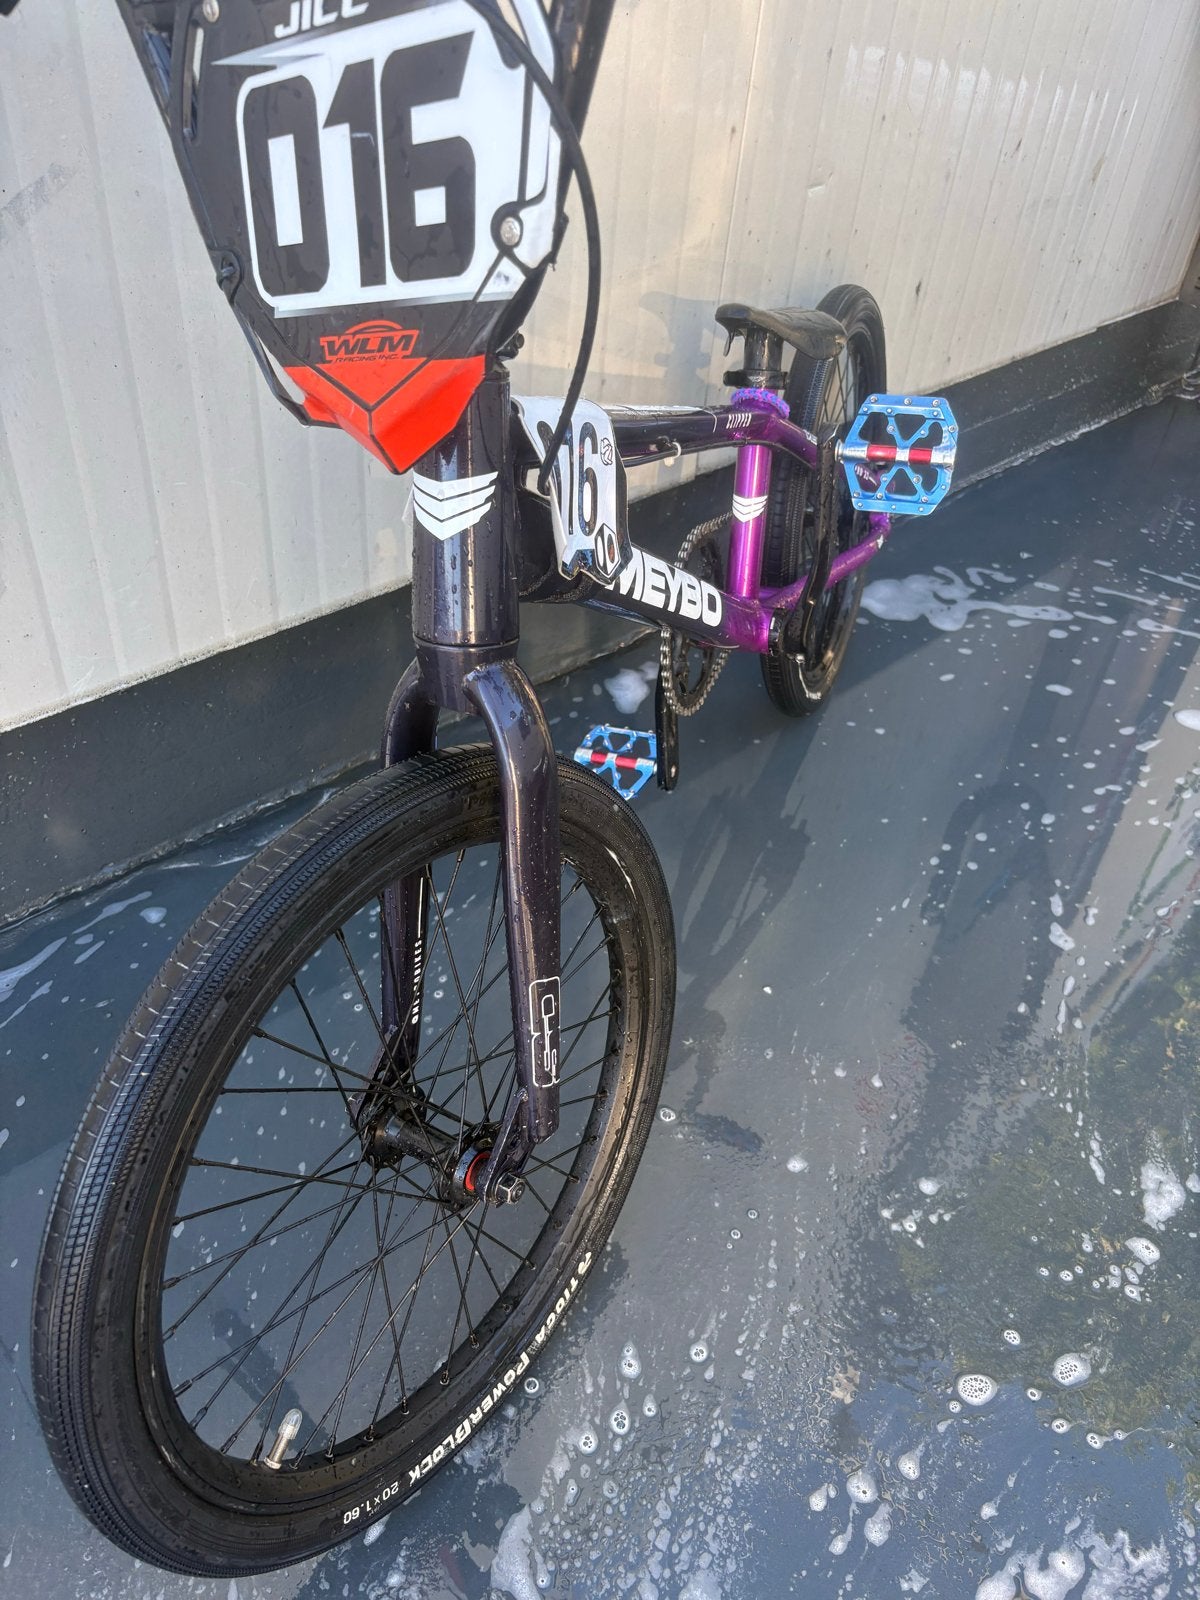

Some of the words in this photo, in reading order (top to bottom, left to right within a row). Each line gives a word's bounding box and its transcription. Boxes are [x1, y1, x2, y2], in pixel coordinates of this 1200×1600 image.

[243, 30, 476, 293] 016
[325, 333, 414, 356] WLM
[335, 355, 377, 363] RACING
[604, 546, 722, 627] MEYBO
